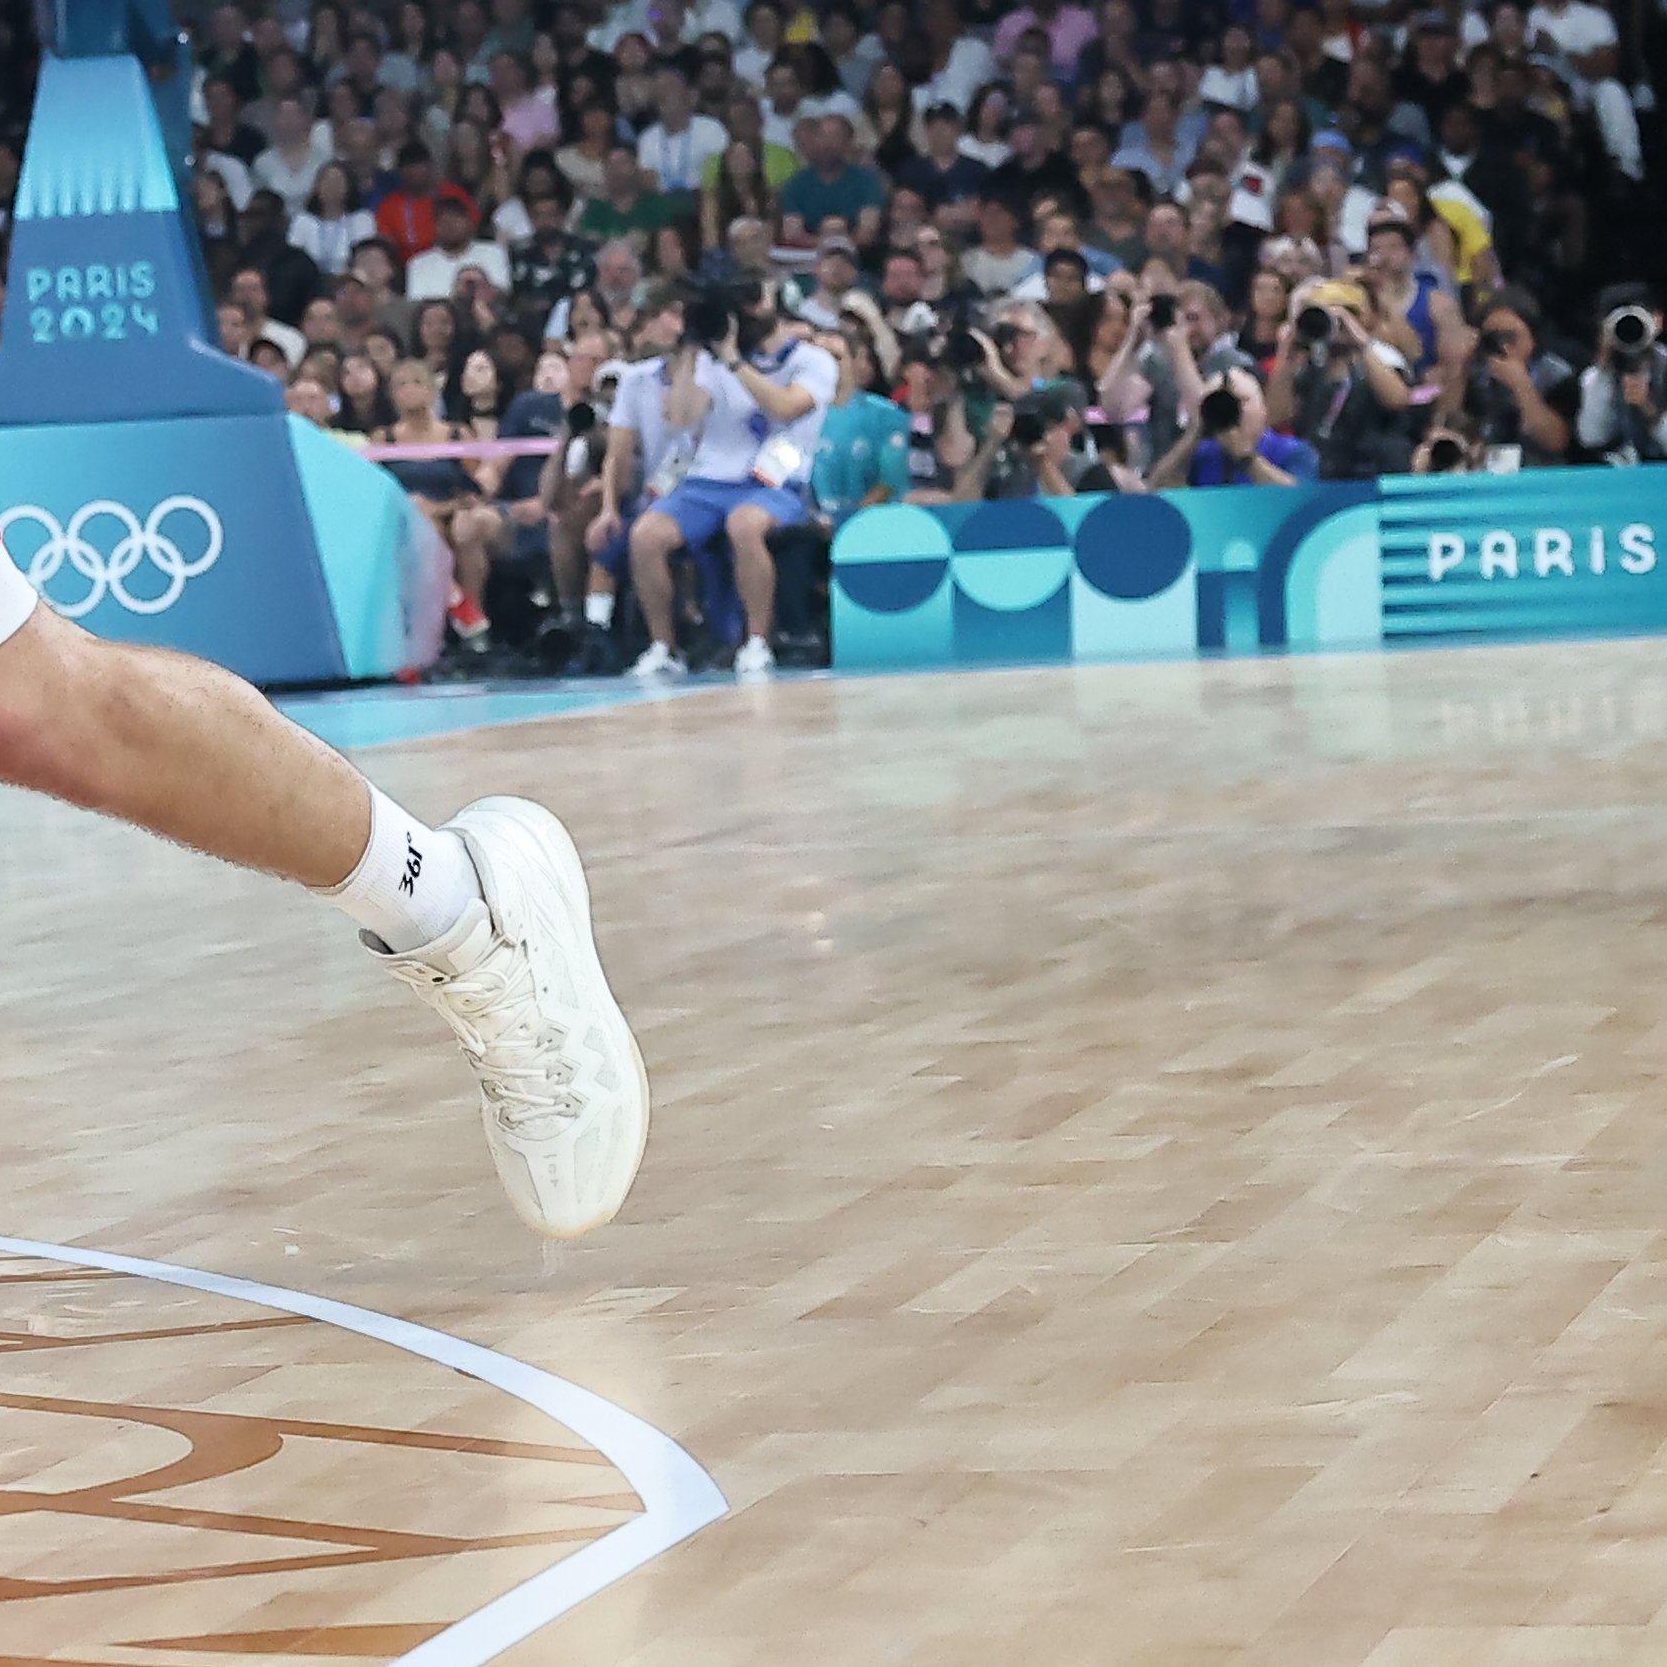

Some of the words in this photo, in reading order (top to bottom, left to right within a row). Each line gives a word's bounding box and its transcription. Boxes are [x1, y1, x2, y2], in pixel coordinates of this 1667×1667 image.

[26, 261, 155, 302] PARIS
[29, 301, 159, 343] 2024
[1428, 522, 1657, 582] PARIS
